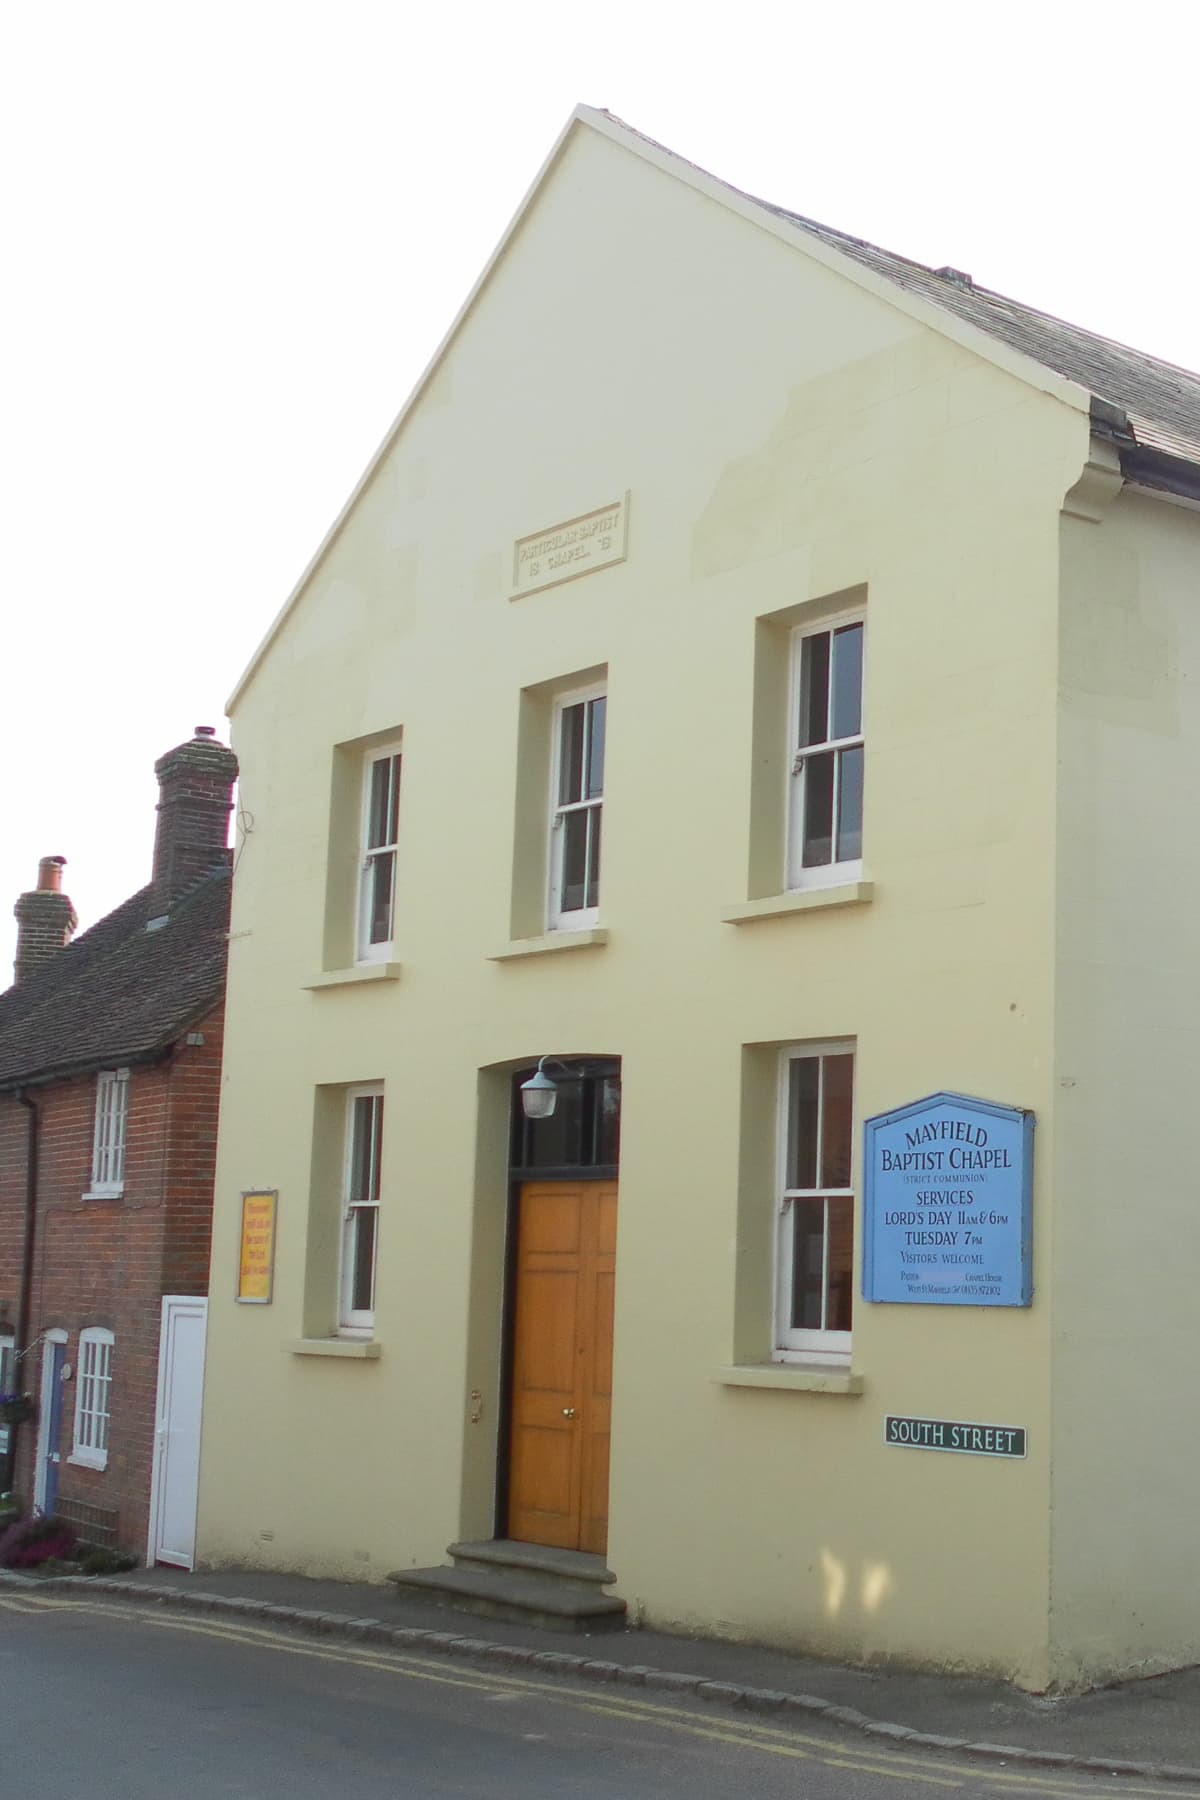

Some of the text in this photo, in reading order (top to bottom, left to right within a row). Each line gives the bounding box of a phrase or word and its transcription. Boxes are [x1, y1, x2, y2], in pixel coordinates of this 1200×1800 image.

[904, 1120, 988, 1150] MAYFIELD
[881, 1147, 1012, 1171] BAPTIST CHAPEL
[916, 1190, 974, 1206] SERVICES
[885, 1210, 924, 1225] LORD'S
[928, 1211, 952, 1225] DAY
[904, 1231, 958, 1246] TUESDAY
[890, 1419, 1017, 1453] SOUTH STREET
